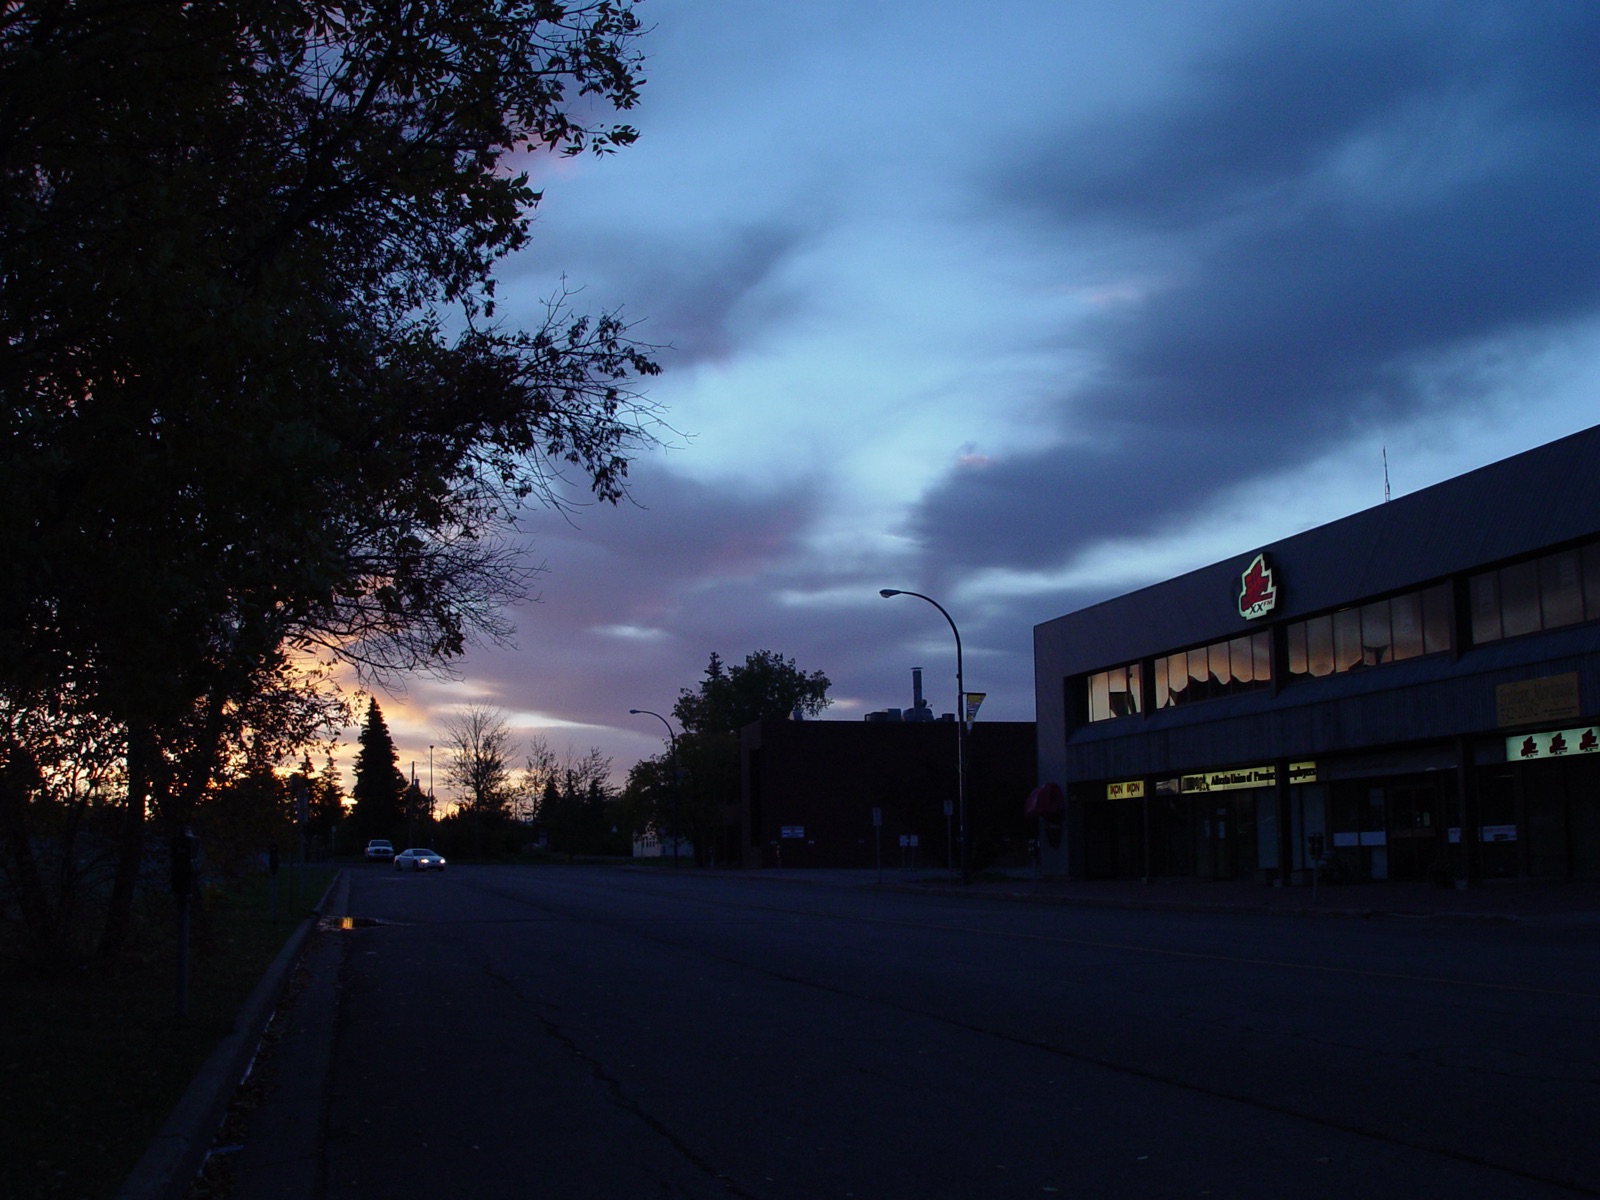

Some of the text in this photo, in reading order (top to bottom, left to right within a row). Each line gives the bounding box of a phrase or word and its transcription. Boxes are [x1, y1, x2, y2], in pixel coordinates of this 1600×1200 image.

[1210, 774, 1230, 786] Alberta
[1230, 773, 1246, 784] Union
[1246, 771, 1253, 782] of
[1253, 770, 1276, 782] Provinc
[1289, 765, 1317, 781] mployees
[1110, 782, 1140, 797] IKON IKON
